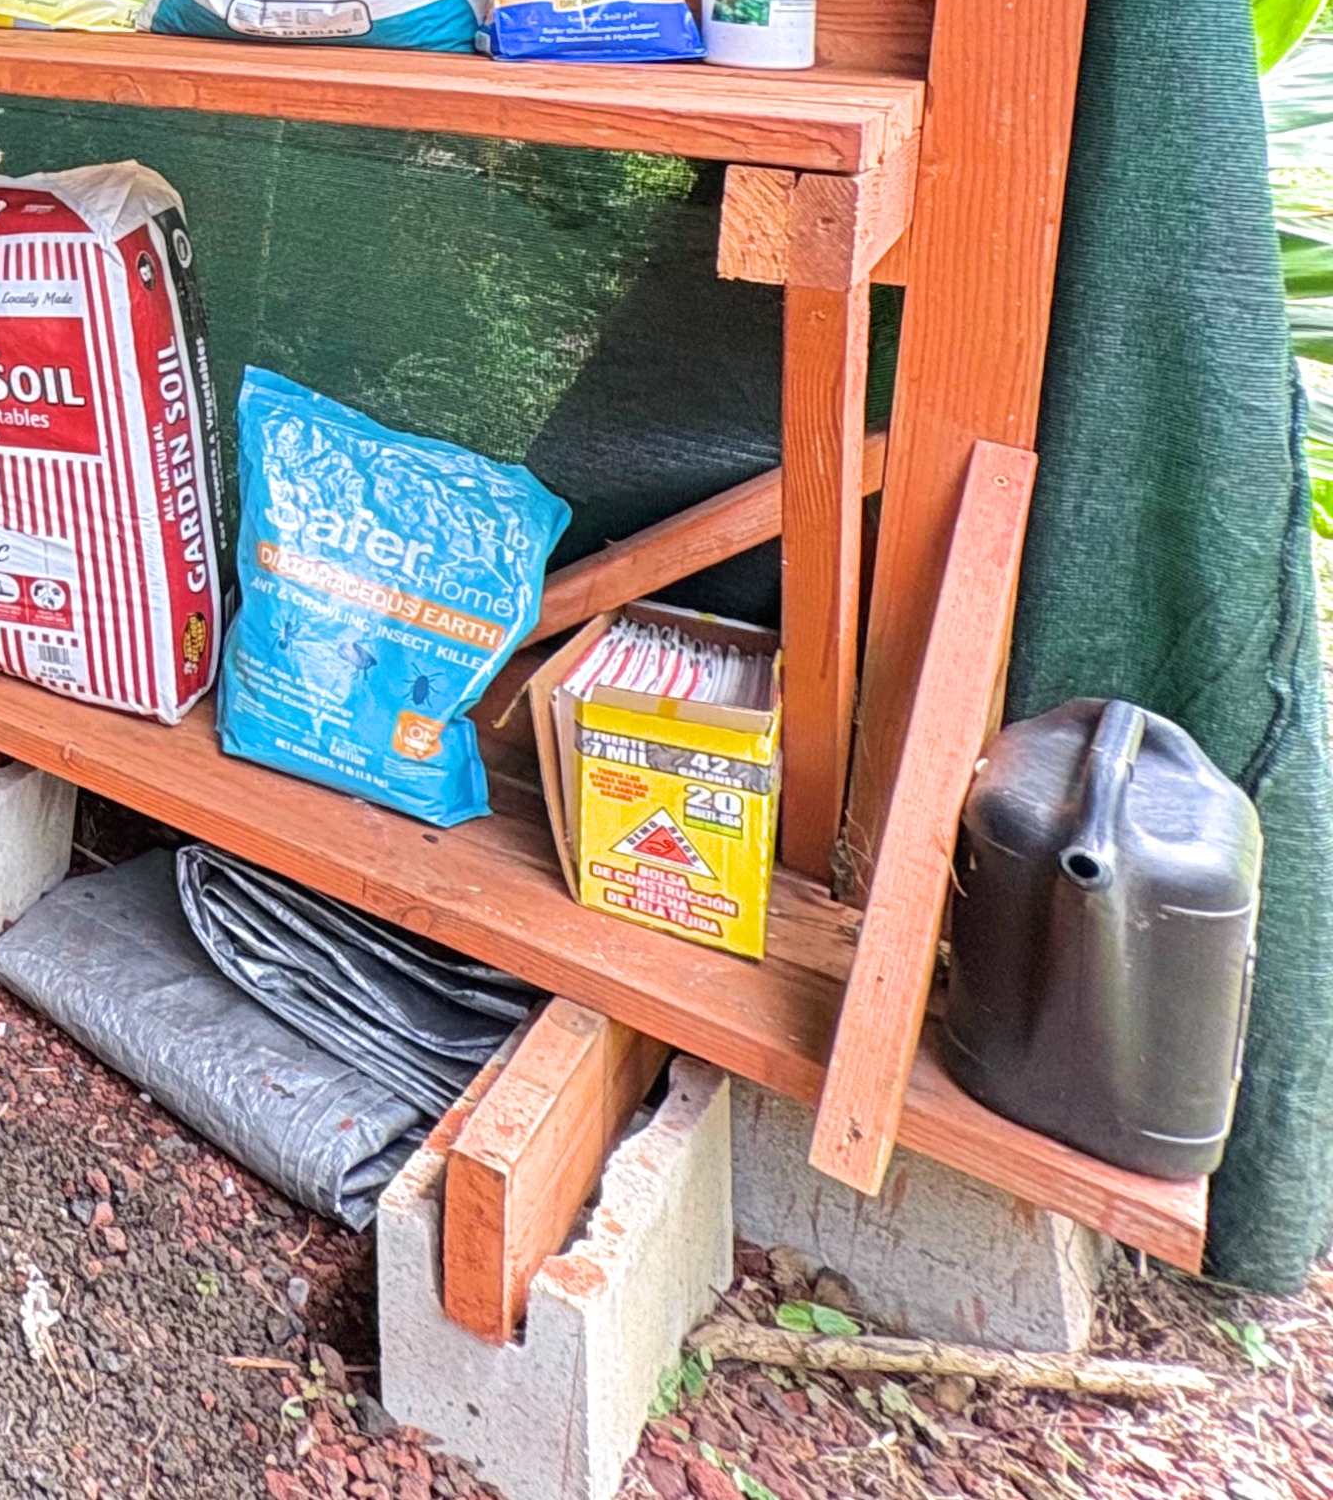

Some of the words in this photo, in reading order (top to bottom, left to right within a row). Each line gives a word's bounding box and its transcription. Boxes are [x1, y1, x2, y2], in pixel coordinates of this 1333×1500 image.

[1, 291, 39, 307] Locally
[42, 291, 73, 304] Made
[157, 335, 186, 425] SOIL
[195, 335, 214, 431] Vegetables
[153, 422, 174, 493] NATURAL
[164, 497, 176, 522] ALL
[170, 431, 207, 594] GARDEN
[503, 525, 529, 550] lb
[418, 566, 514, 619] Home
[250, 576, 276, 596] ANT
[276, 588, 288, 601] &
[291, 590, 371, 633] CRAWLING
[375, 625, 432, 653] INSECT
[436, 644, 494, 675] KILLER
[423, 609, 498, 646] EARTH
[330, 745, 367, 767] CAUTION
[588, 741, 605, 758] 7
[606, 747, 651, 769] MIL
[593, 732, 647, 751] FUERTE
[677, 766, 743, 789] GALONES
[690, 752, 731, 777] 42
[684, 784, 743, 813] 20
[626, 819, 659, 847] DEMO
[668, 825, 701, 864] BAGS
[591, 863, 613, 879] DE
[614, 870, 737, 916] CONSTRUCCIÓN
[637, 864, 688, 888] BOLSA
[606, 889, 627, 906] DE
[627, 897, 669, 921] TELA
[668, 906, 723, 935] TEJIDA
[636, 888, 690, 913] HECHA
